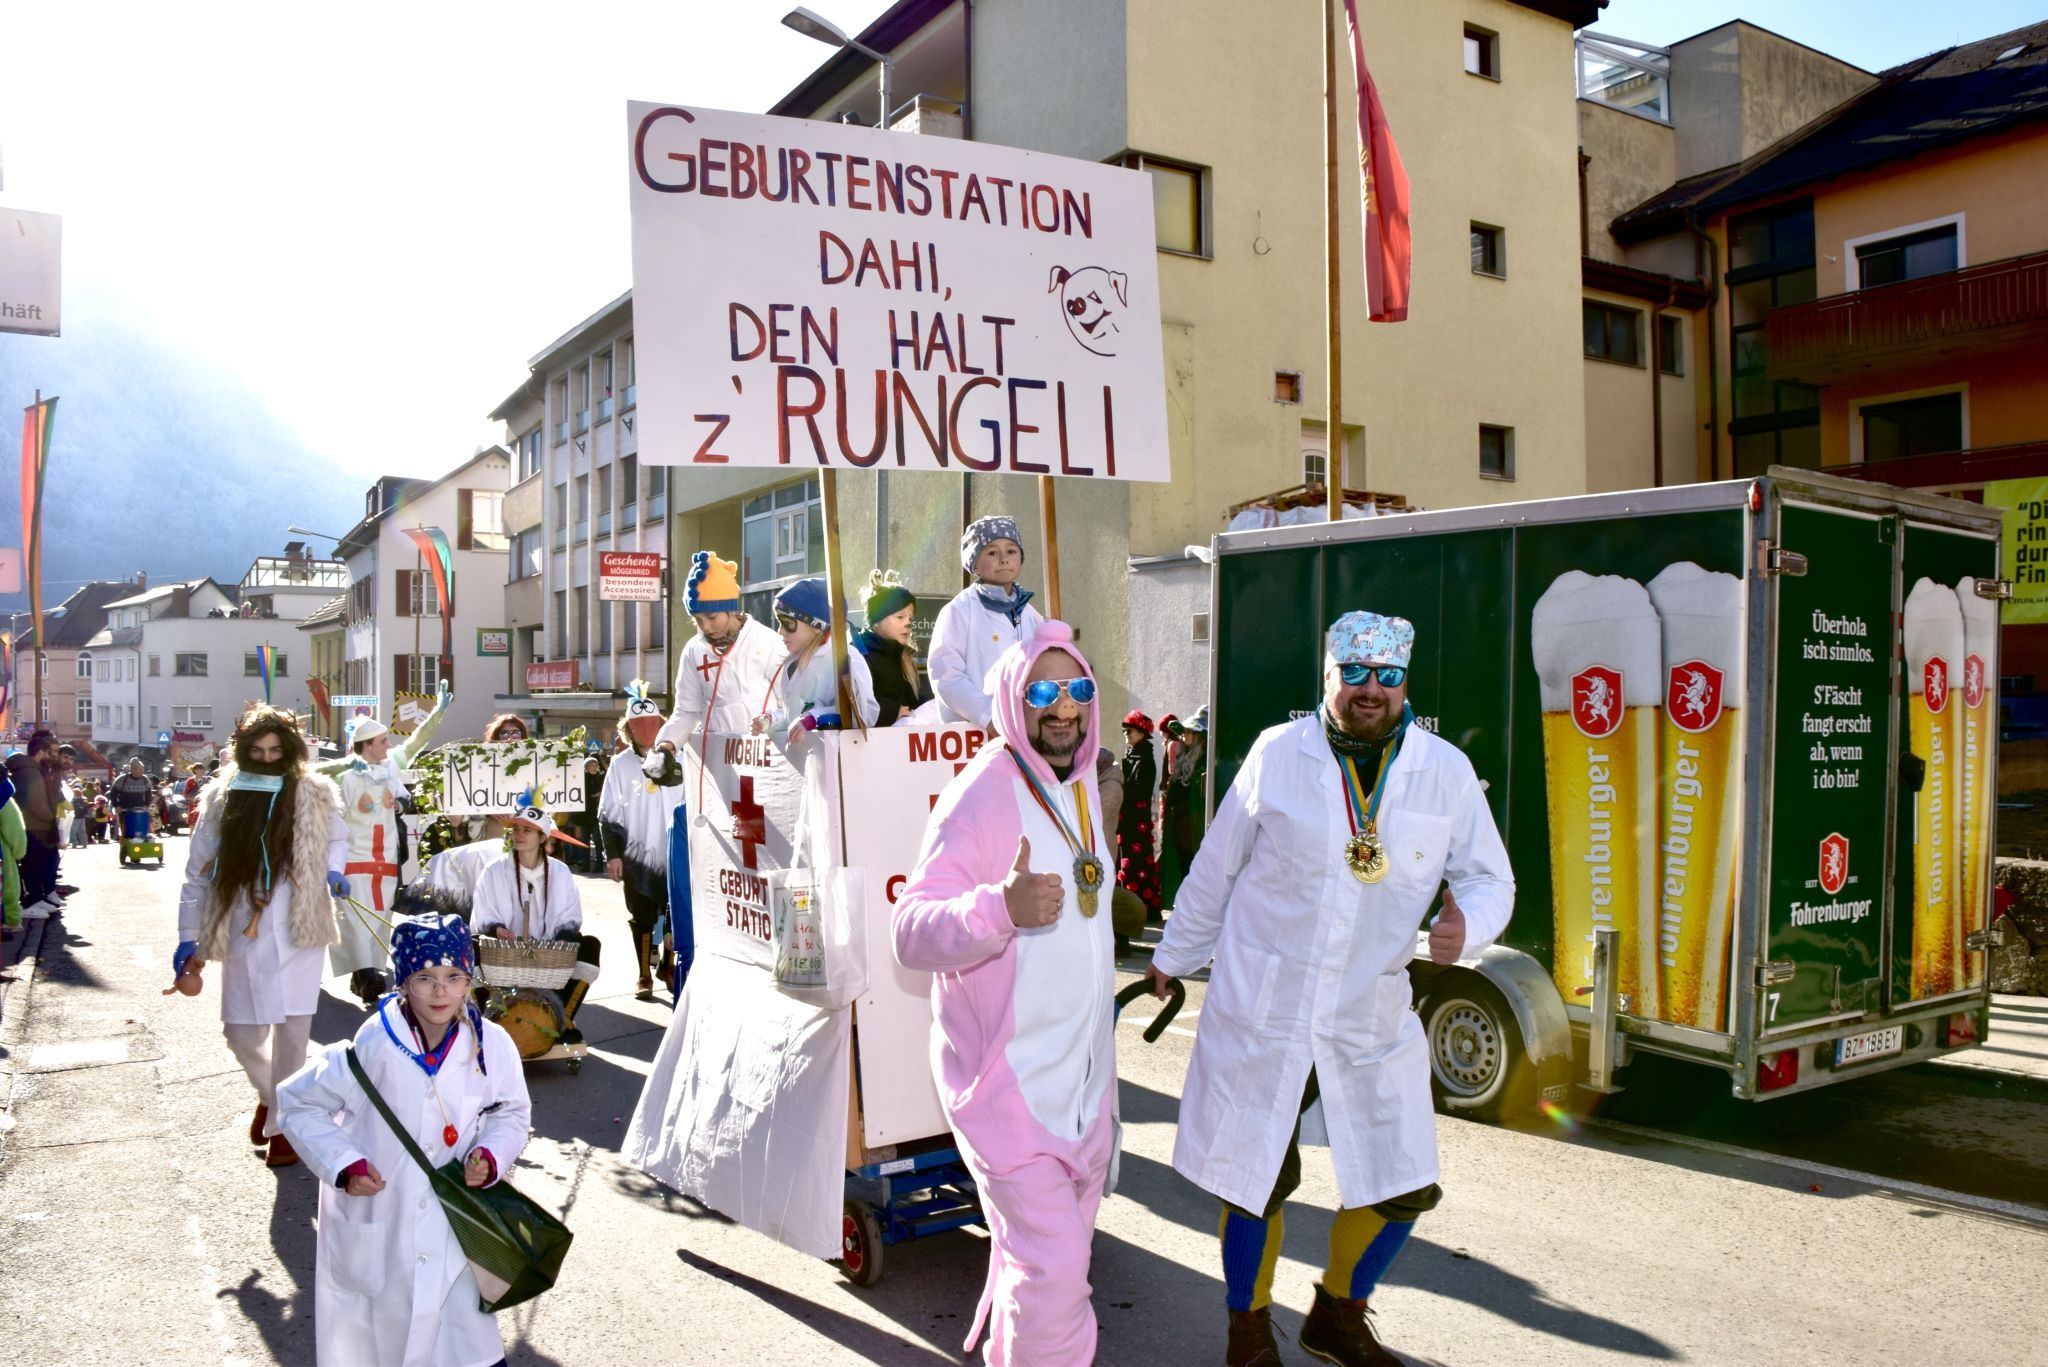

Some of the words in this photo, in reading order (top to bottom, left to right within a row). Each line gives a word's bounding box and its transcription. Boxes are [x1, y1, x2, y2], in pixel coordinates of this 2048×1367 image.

[633, 107, 1093, 239] GEBURTENSTATION
[819, 230, 952, 301] DAHI,
[0, 301, 42, 321] häft
[729, 302, 838, 365] DEN
[888, 309, 1016, 376] HALT
[603, 553, 657, 567] Geschenke
[610, 566, 650, 575] MÖGGENRIED
[605, 578, 654, 586] besondere
[2015, 564, 2046, 584] Fin
[604, 586, 657, 594] Accessoires
[1812, 609, 1867, 636] Überhola
[1803, 638, 1828, 660] isch
[1829, 641, 1875, 662] sinnlos.
[1813, 684, 1862, 706] S'Fäscht
[1802, 712, 1834, 738] fangt
[1835, 713, 1872, 733] erscht
[724, 738, 771, 767] MOBILE
[1810, 741, 1829, 763] ah,
[1830, 745, 1863, 760] wenn
[1819, 769, 1835, 788] do
[1836, 768, 1860, 788] bin!
[1790, 898, 1872, 927] Fohrenburger
[1769, 992, 1781, 1022] 7
